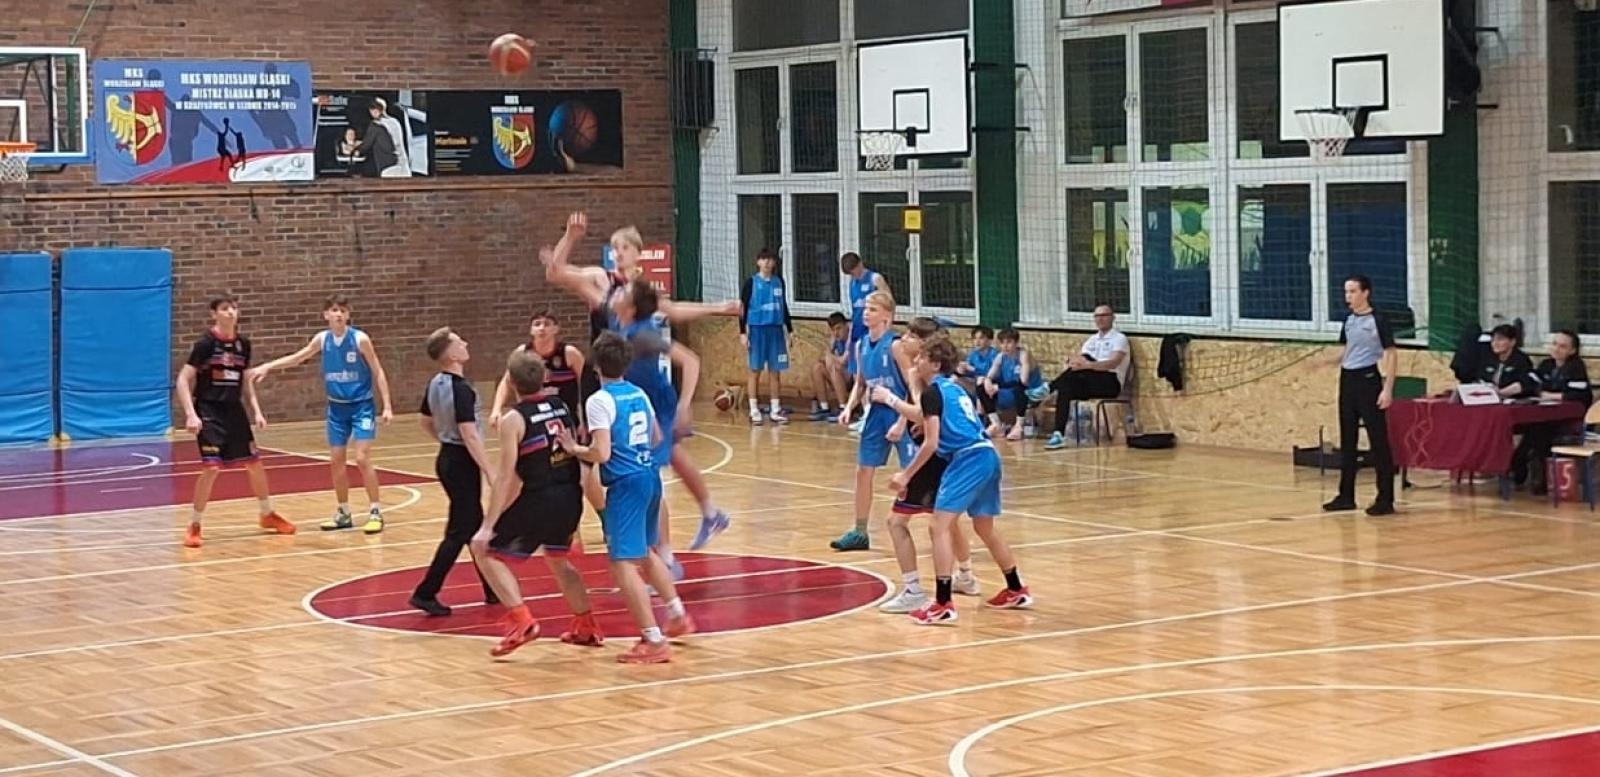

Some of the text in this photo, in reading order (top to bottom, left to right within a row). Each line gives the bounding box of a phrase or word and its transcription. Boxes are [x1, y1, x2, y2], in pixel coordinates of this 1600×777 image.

[124, 68, 143, 78] MKS
[180, 73, 200, 85] MKS
[202, 73, 257, 85] WODZISŁAW
[629, 411, 649, 446] 2
